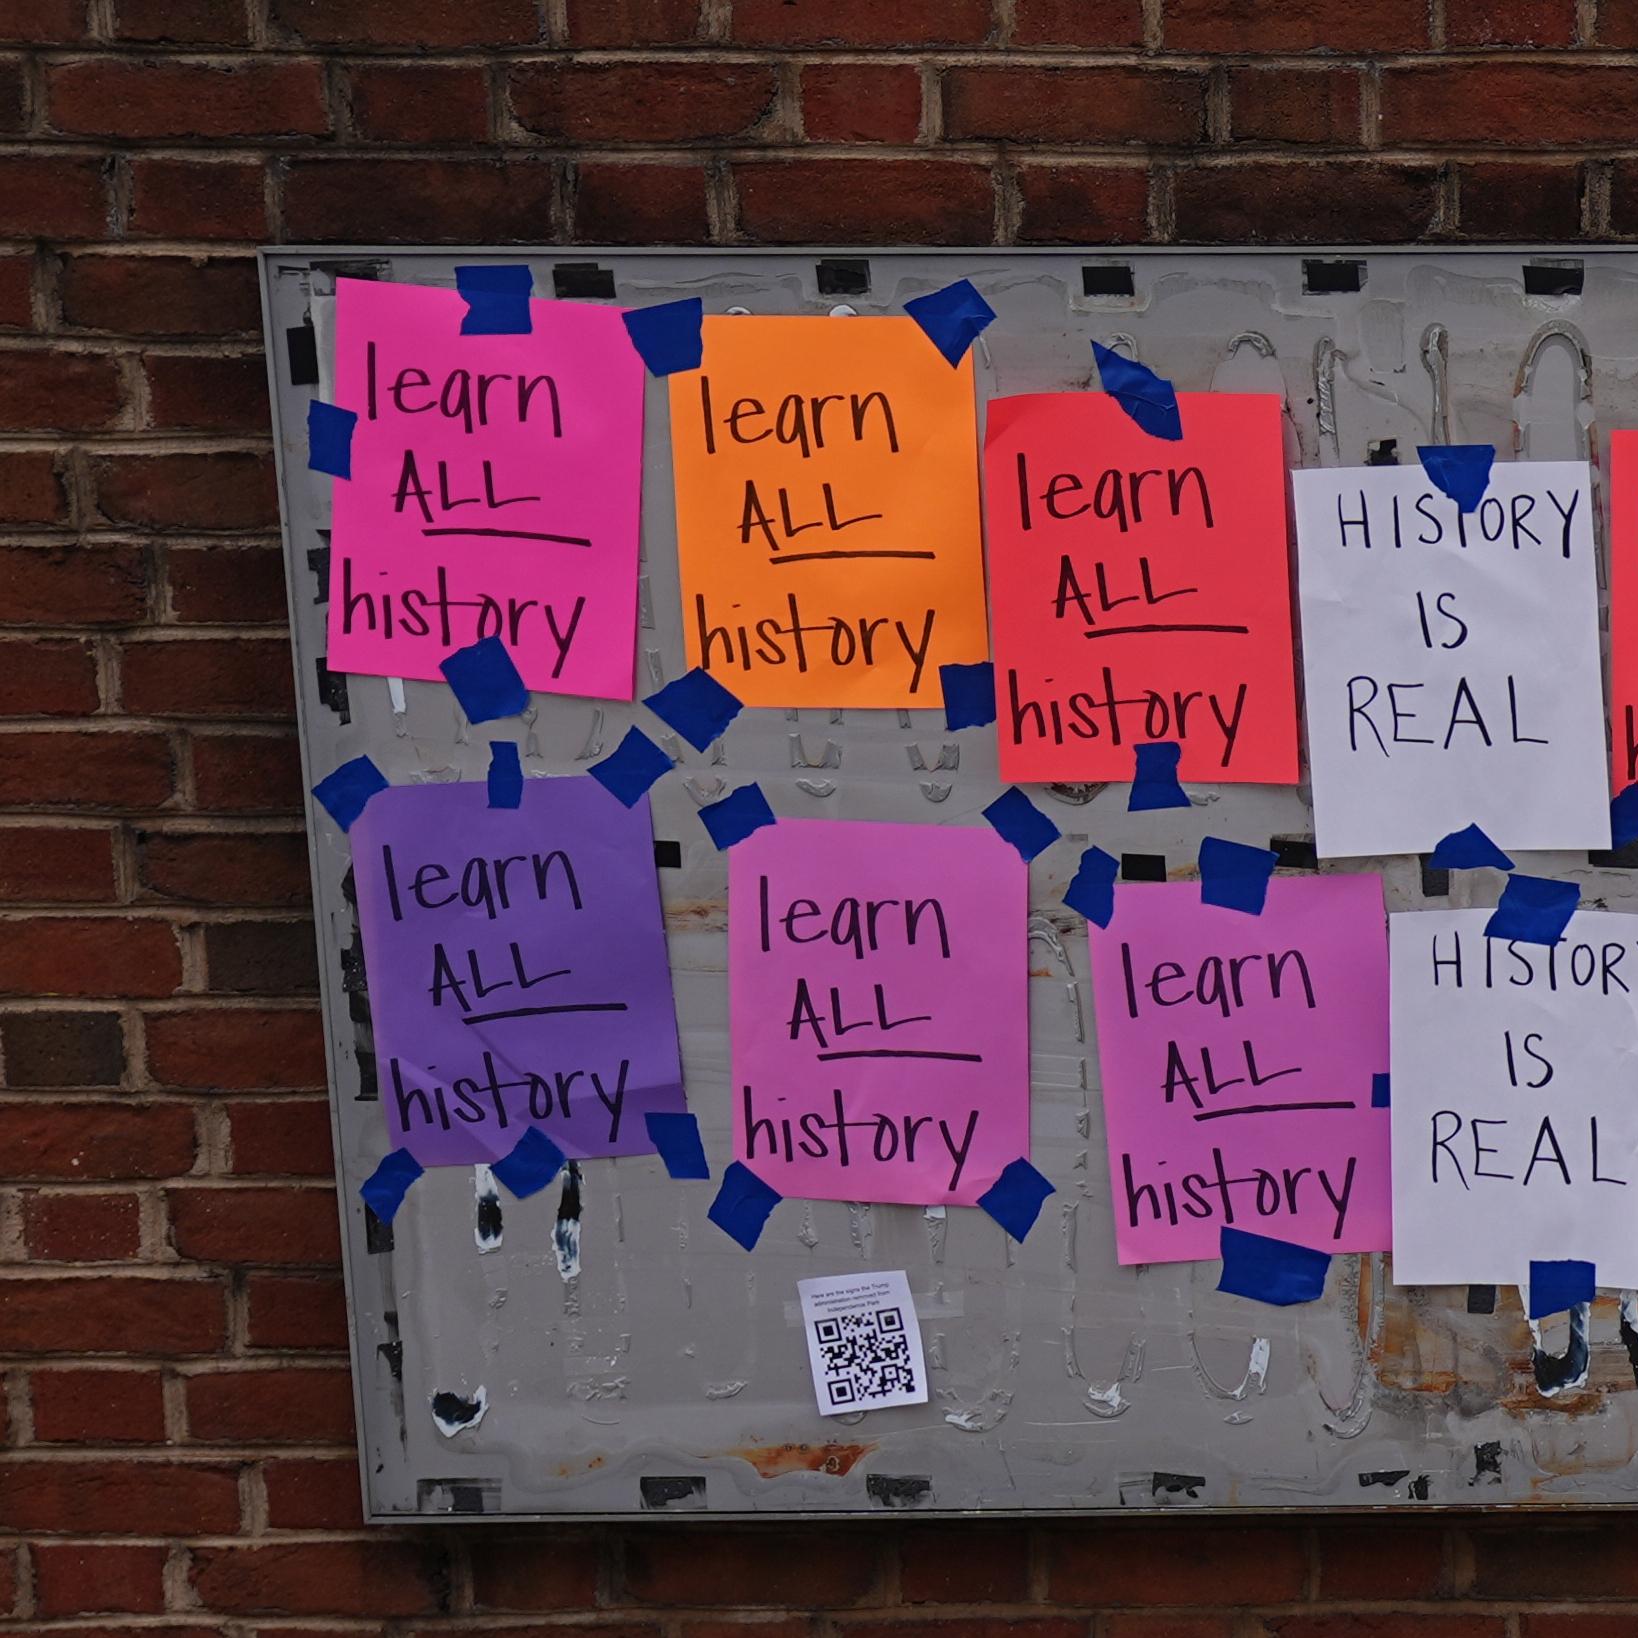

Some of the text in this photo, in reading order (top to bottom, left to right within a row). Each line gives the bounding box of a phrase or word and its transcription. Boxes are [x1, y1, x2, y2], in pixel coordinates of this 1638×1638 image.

[367, 342, 562, 437] learn
[701, 376, 898, 457] learn
[393, 450, 540, 522] ALL
[739, 480, 882, 550] ALL
[1017, 453, 1213, 532] learn
[343, 557, 585, 678] history
[1053, 555, 1198, 625] ALL
[1417, 592, 1468, 649] IS
[696, 594, 935, 693] history
[1008, 667, 1247, 766] history
[1346, 676, 1549, 757] REAL
[382, 845, 582, 920] learn
[760, 875, 950, 959] learn
[429, 942, 571, 1012] ALL
[787, 977, 931, 1048] ALL
[1121, 942, 1315, 1018] learn
[390, 1051, 629, 1142] history
[1160, 1040, 1302, 1108] ALL
[1505, 1031, 1553, 1088] IS
[744, 1086, 978, 1191] history
[1431, 1110, 1627, 1190] REAL
[1122, 1148, 1356, 1239] history
